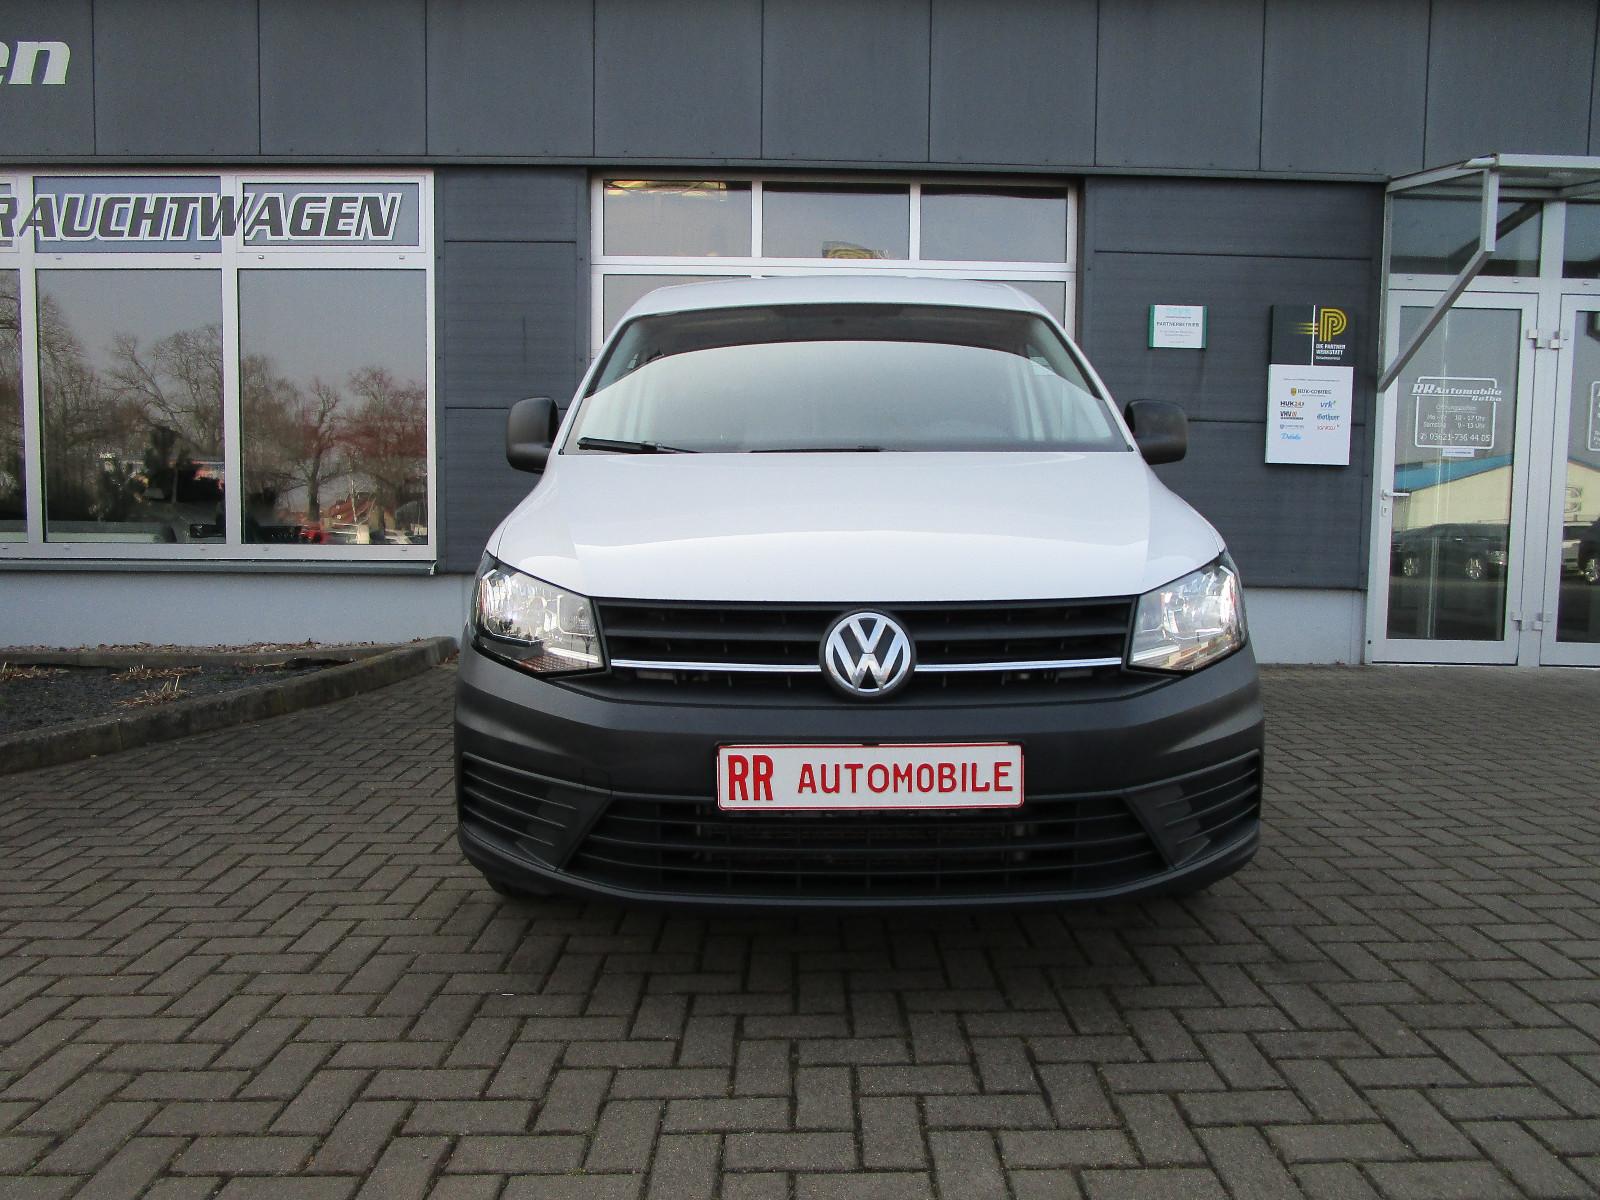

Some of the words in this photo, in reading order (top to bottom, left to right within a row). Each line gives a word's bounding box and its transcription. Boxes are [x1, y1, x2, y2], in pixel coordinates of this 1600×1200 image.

[0, 41, 71, 85] n
[727, 754, 774, 801] RR
[797, 761, 1014, 794] AUTOMOBILE
